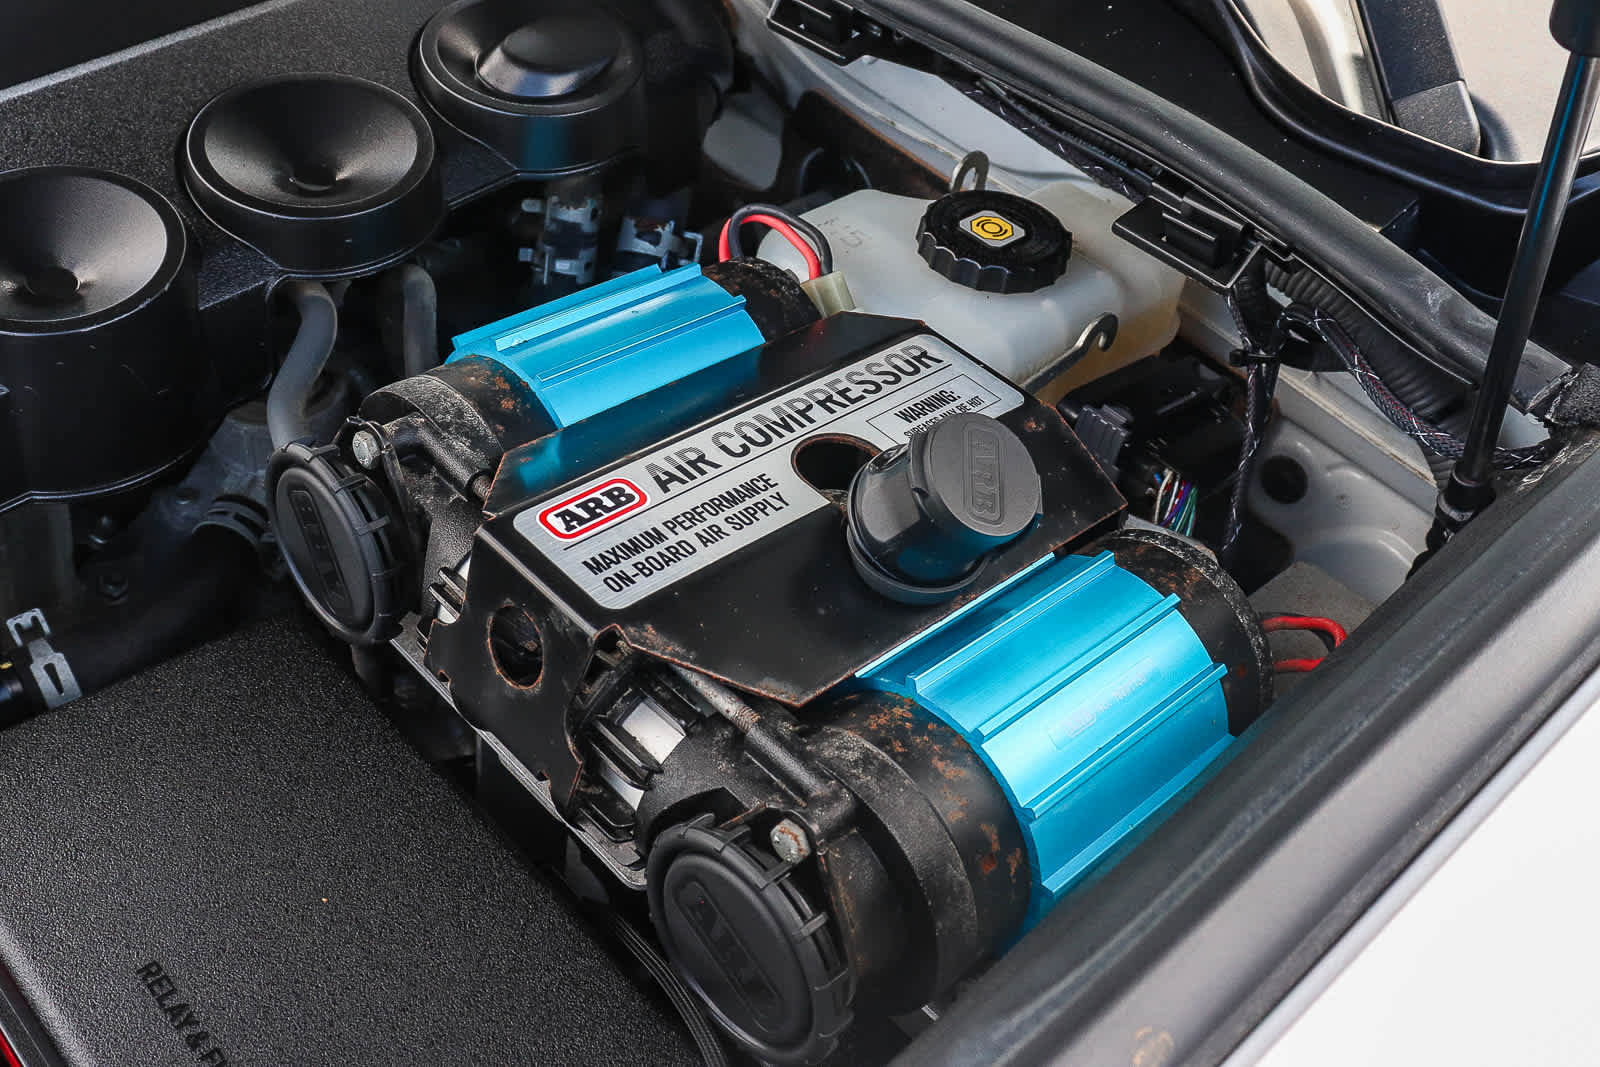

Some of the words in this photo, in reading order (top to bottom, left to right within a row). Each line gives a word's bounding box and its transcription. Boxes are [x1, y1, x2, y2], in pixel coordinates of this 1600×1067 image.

[643, 446, 723, 494] AIR
[711, 343, 945, 459] COMPRESSOR
[893, 389, 962, 424] WARNING:
[955, 402, 972, 414] BE
[966, 395, 985, 409] HOT
[553, 485, 636, 533] ARB
[581, 526, 668, 576] MAXIMUM
[661, 472, 779, 537] PERFORMANCE
[602, 538, 698, 593] ON-BOARD
[694, 523, 731, 549] AIR
[724, 491, 791, 532] SUPPLY
[136, 960, 200, 1029] RELAY
